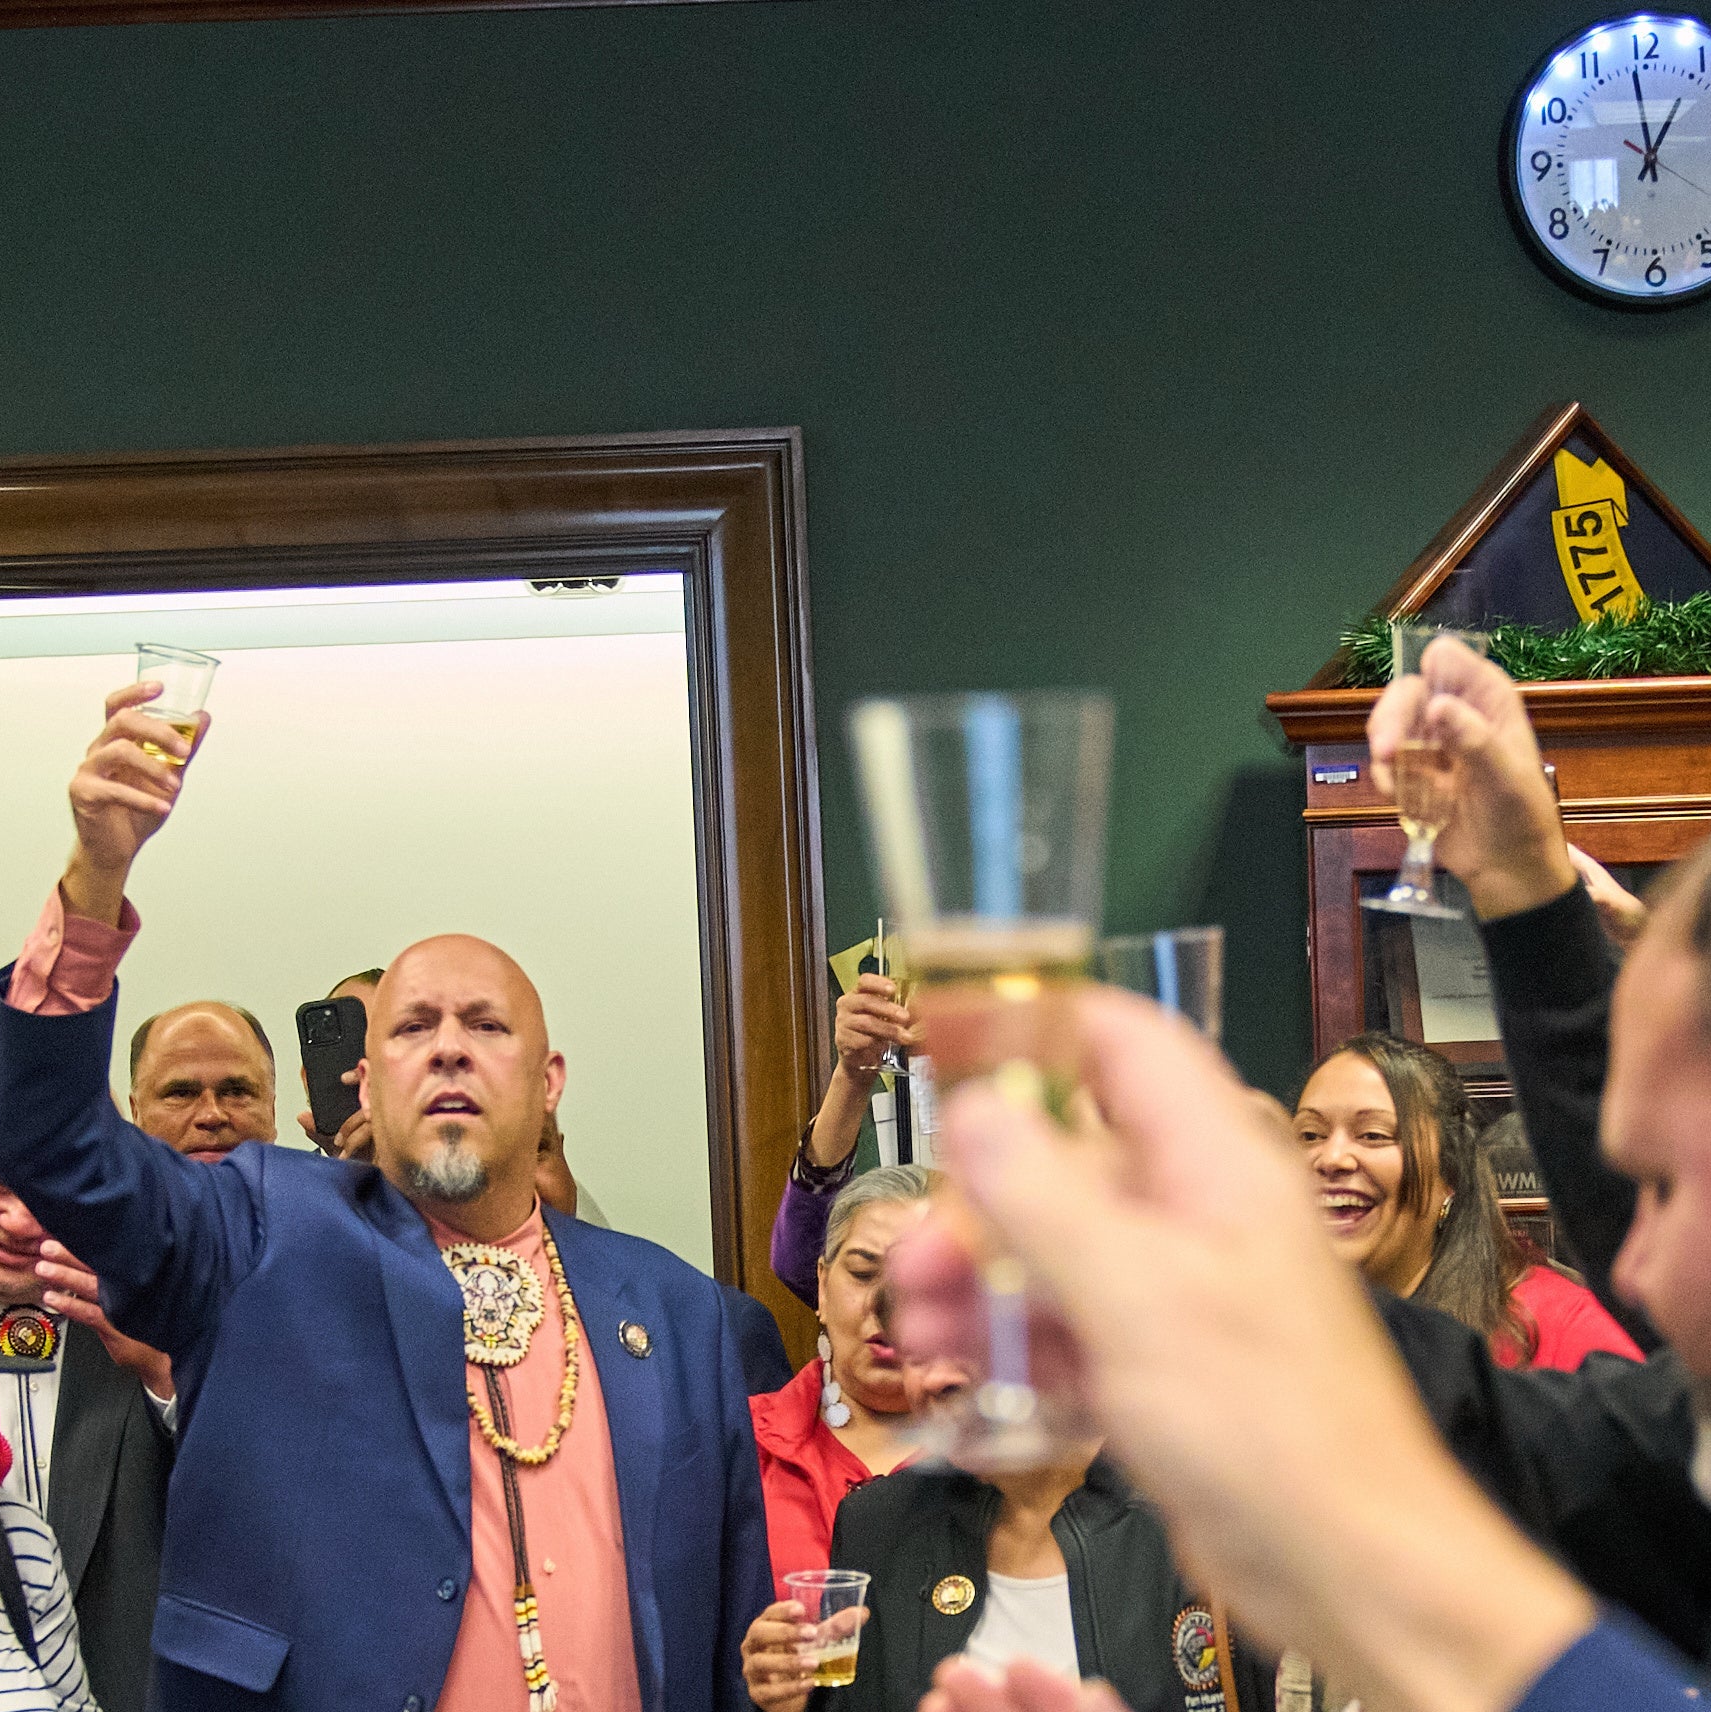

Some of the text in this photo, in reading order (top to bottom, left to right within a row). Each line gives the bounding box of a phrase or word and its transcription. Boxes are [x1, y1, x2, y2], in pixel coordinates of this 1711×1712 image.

[1632, 31, 1659, 60] 12
[1698, 45, 1706, 73] 1
[1580, 51, 1600, 79] 11
[1540, 97, 1567, 126] 10
[1530, 150, 1552, 182] 9
[1549, 207, 1569, 240] 8
[1593, 248, 1611, 276] 7
[1644, 256, 1667, 287] 6
[1564, 510, 1624, 613] 1775
